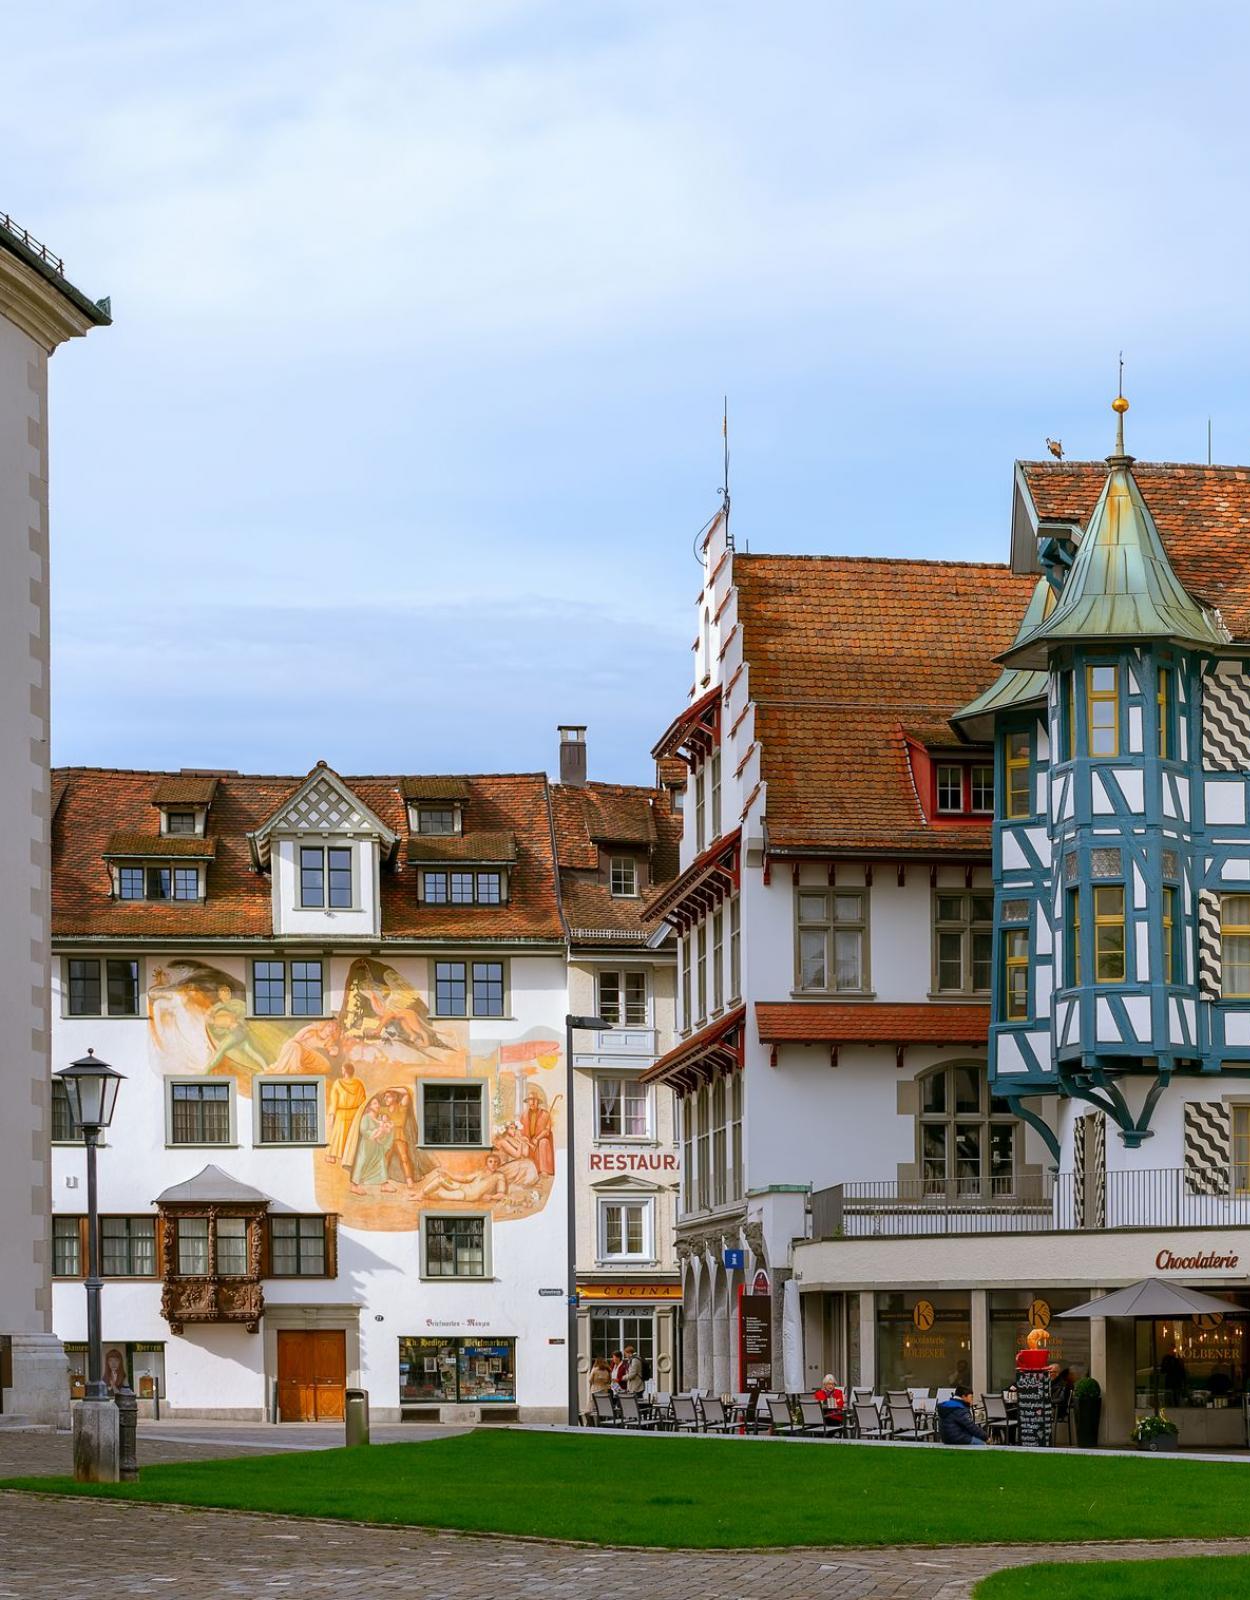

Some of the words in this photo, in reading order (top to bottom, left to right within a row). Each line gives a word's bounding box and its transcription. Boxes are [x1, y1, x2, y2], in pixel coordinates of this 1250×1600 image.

[1155, 1249, 1239, 1270] Chocolaterie
[603, 1287, 671, 1295] COCINA
[593, 1307, 649, 1316] TAPAS
